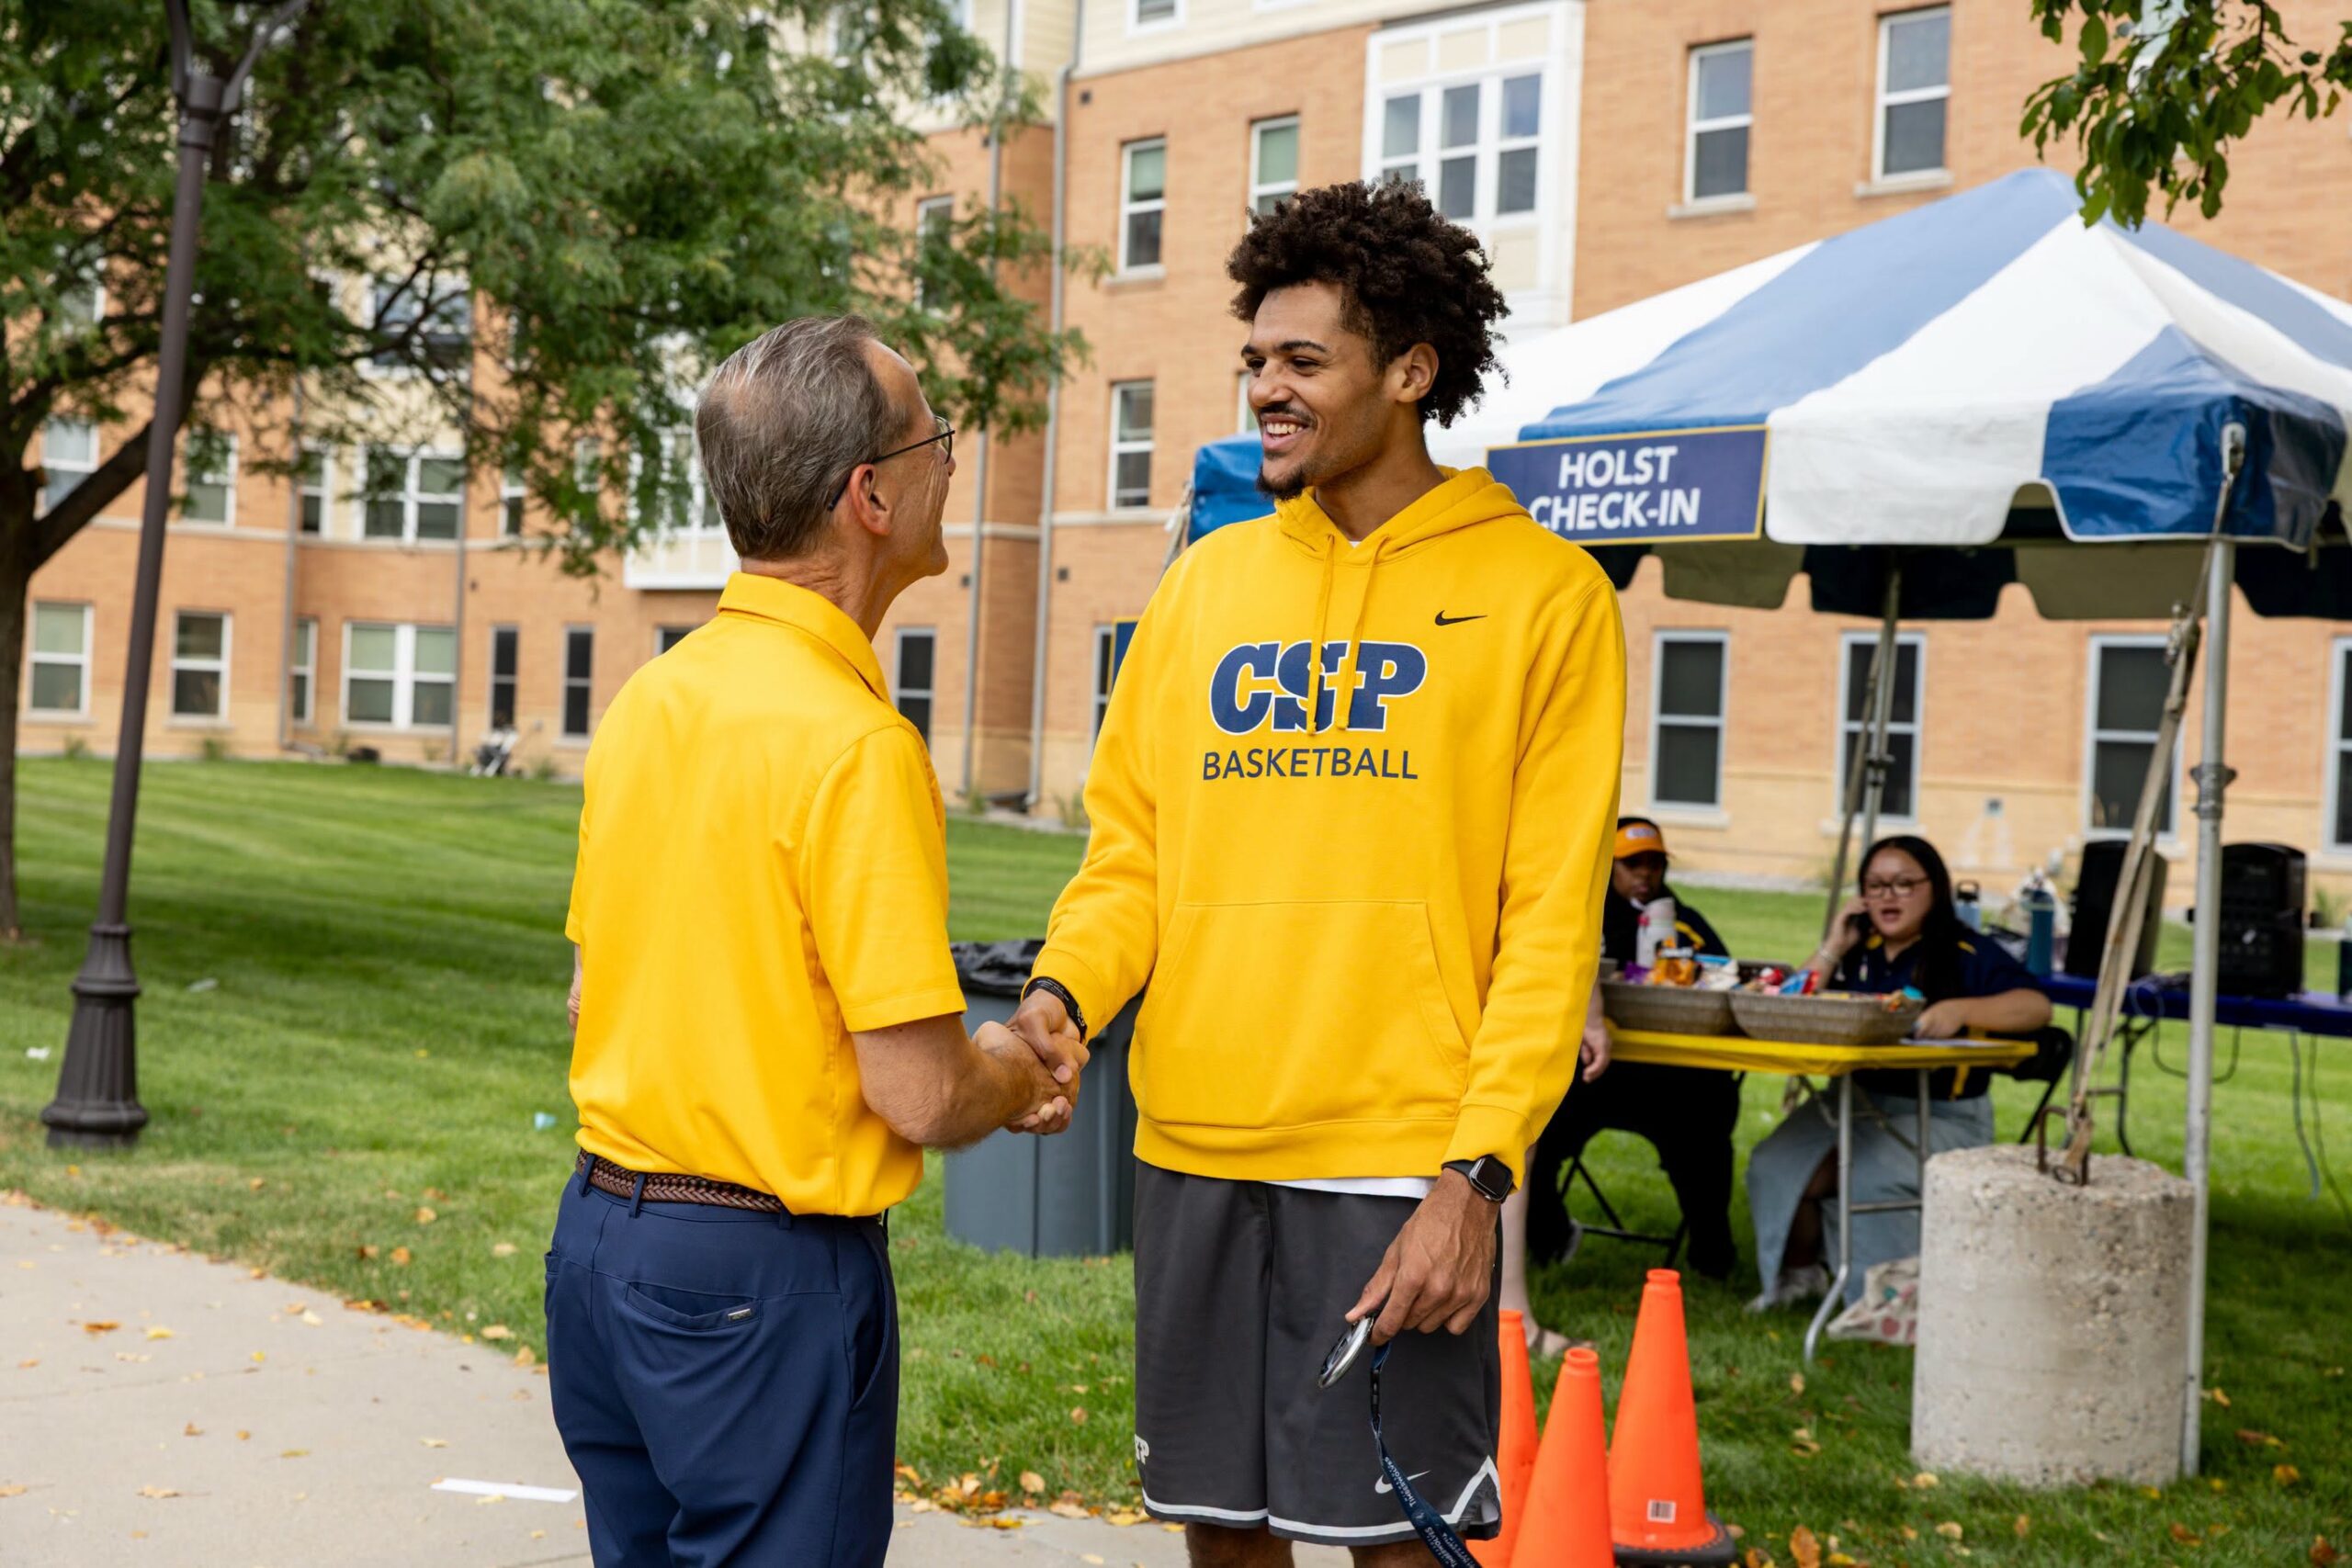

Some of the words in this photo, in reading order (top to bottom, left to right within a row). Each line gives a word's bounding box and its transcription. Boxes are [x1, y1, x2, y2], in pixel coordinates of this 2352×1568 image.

[1558, 446, 1679, 490] HOLST
[1529, 487, 1701, 532] CHECK-IN
[1209, 639, 1428, 736] CSP
[1203, 748, 1419, 781] BASKETBALL
